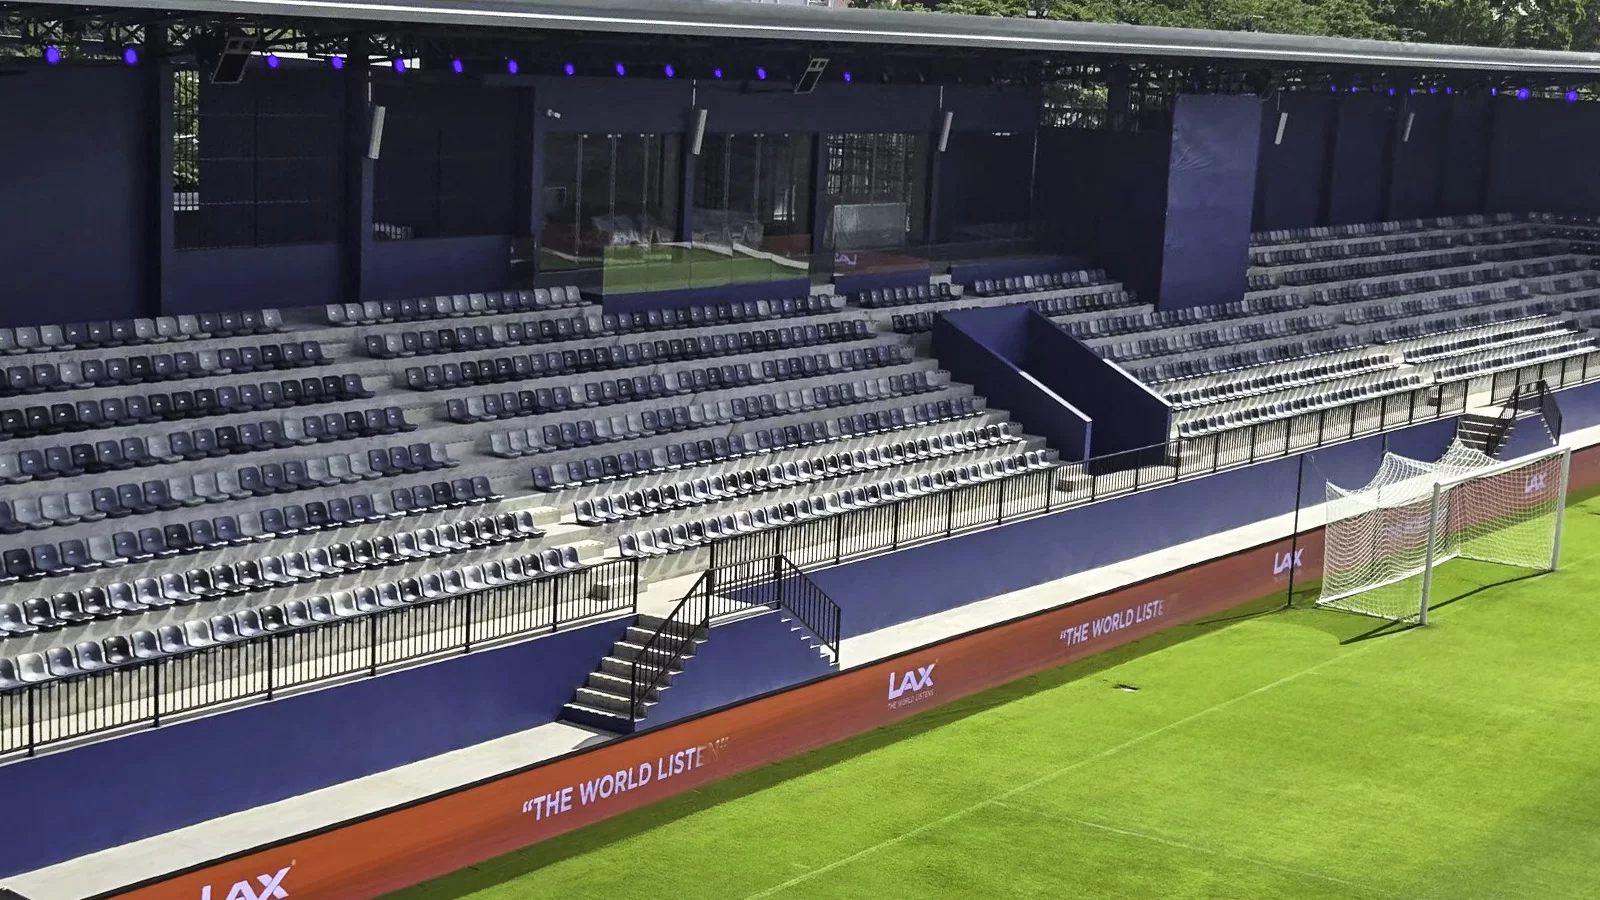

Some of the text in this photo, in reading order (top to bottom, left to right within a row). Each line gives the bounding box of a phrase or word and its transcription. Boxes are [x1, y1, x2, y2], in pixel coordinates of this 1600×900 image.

[1273, 548, 1304, 574] LAX
[1092, 608, 1134, 638] WORLD
[888, 663, 936, 700] LAX
[579, 762, 651, 806] WORLD
